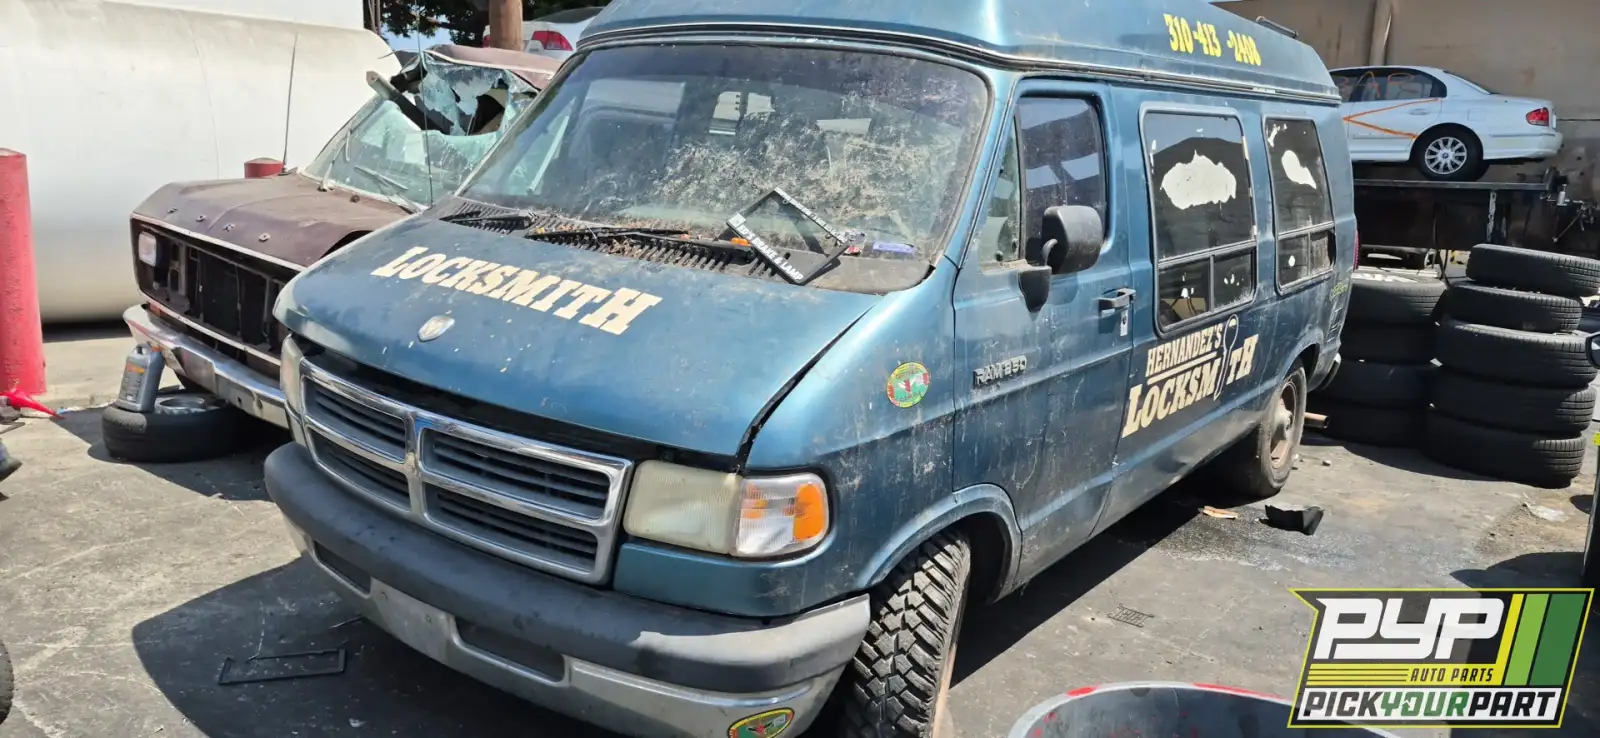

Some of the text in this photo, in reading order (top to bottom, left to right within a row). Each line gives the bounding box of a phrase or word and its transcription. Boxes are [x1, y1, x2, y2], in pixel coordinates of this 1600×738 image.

[752, 237, 778, 259] BRAKE
[780, 261, 805, 280] LAMP
[371, 246, 663, 335] LOCKSMITH
[1145, 322, 1224, 378] HERNANDEZ'S
